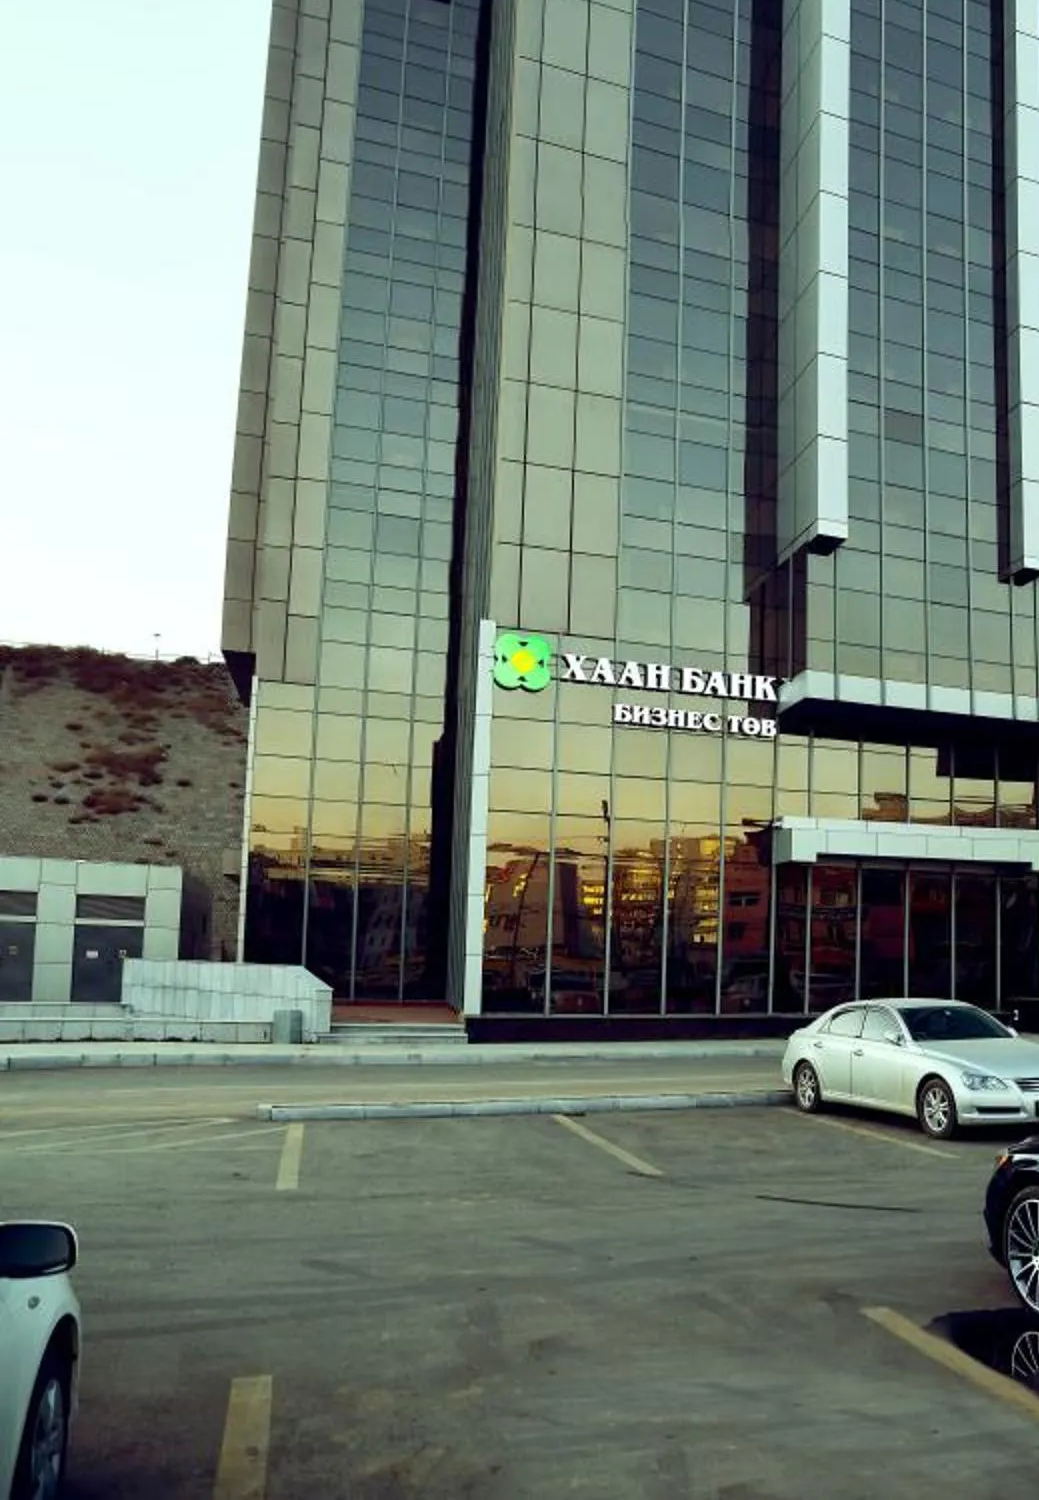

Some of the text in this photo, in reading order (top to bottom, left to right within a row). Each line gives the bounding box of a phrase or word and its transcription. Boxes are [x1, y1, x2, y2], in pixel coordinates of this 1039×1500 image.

[562, 652, 778, 702] ХААН БАНК
[614, 703, 721, 731] БИЗНЕС
